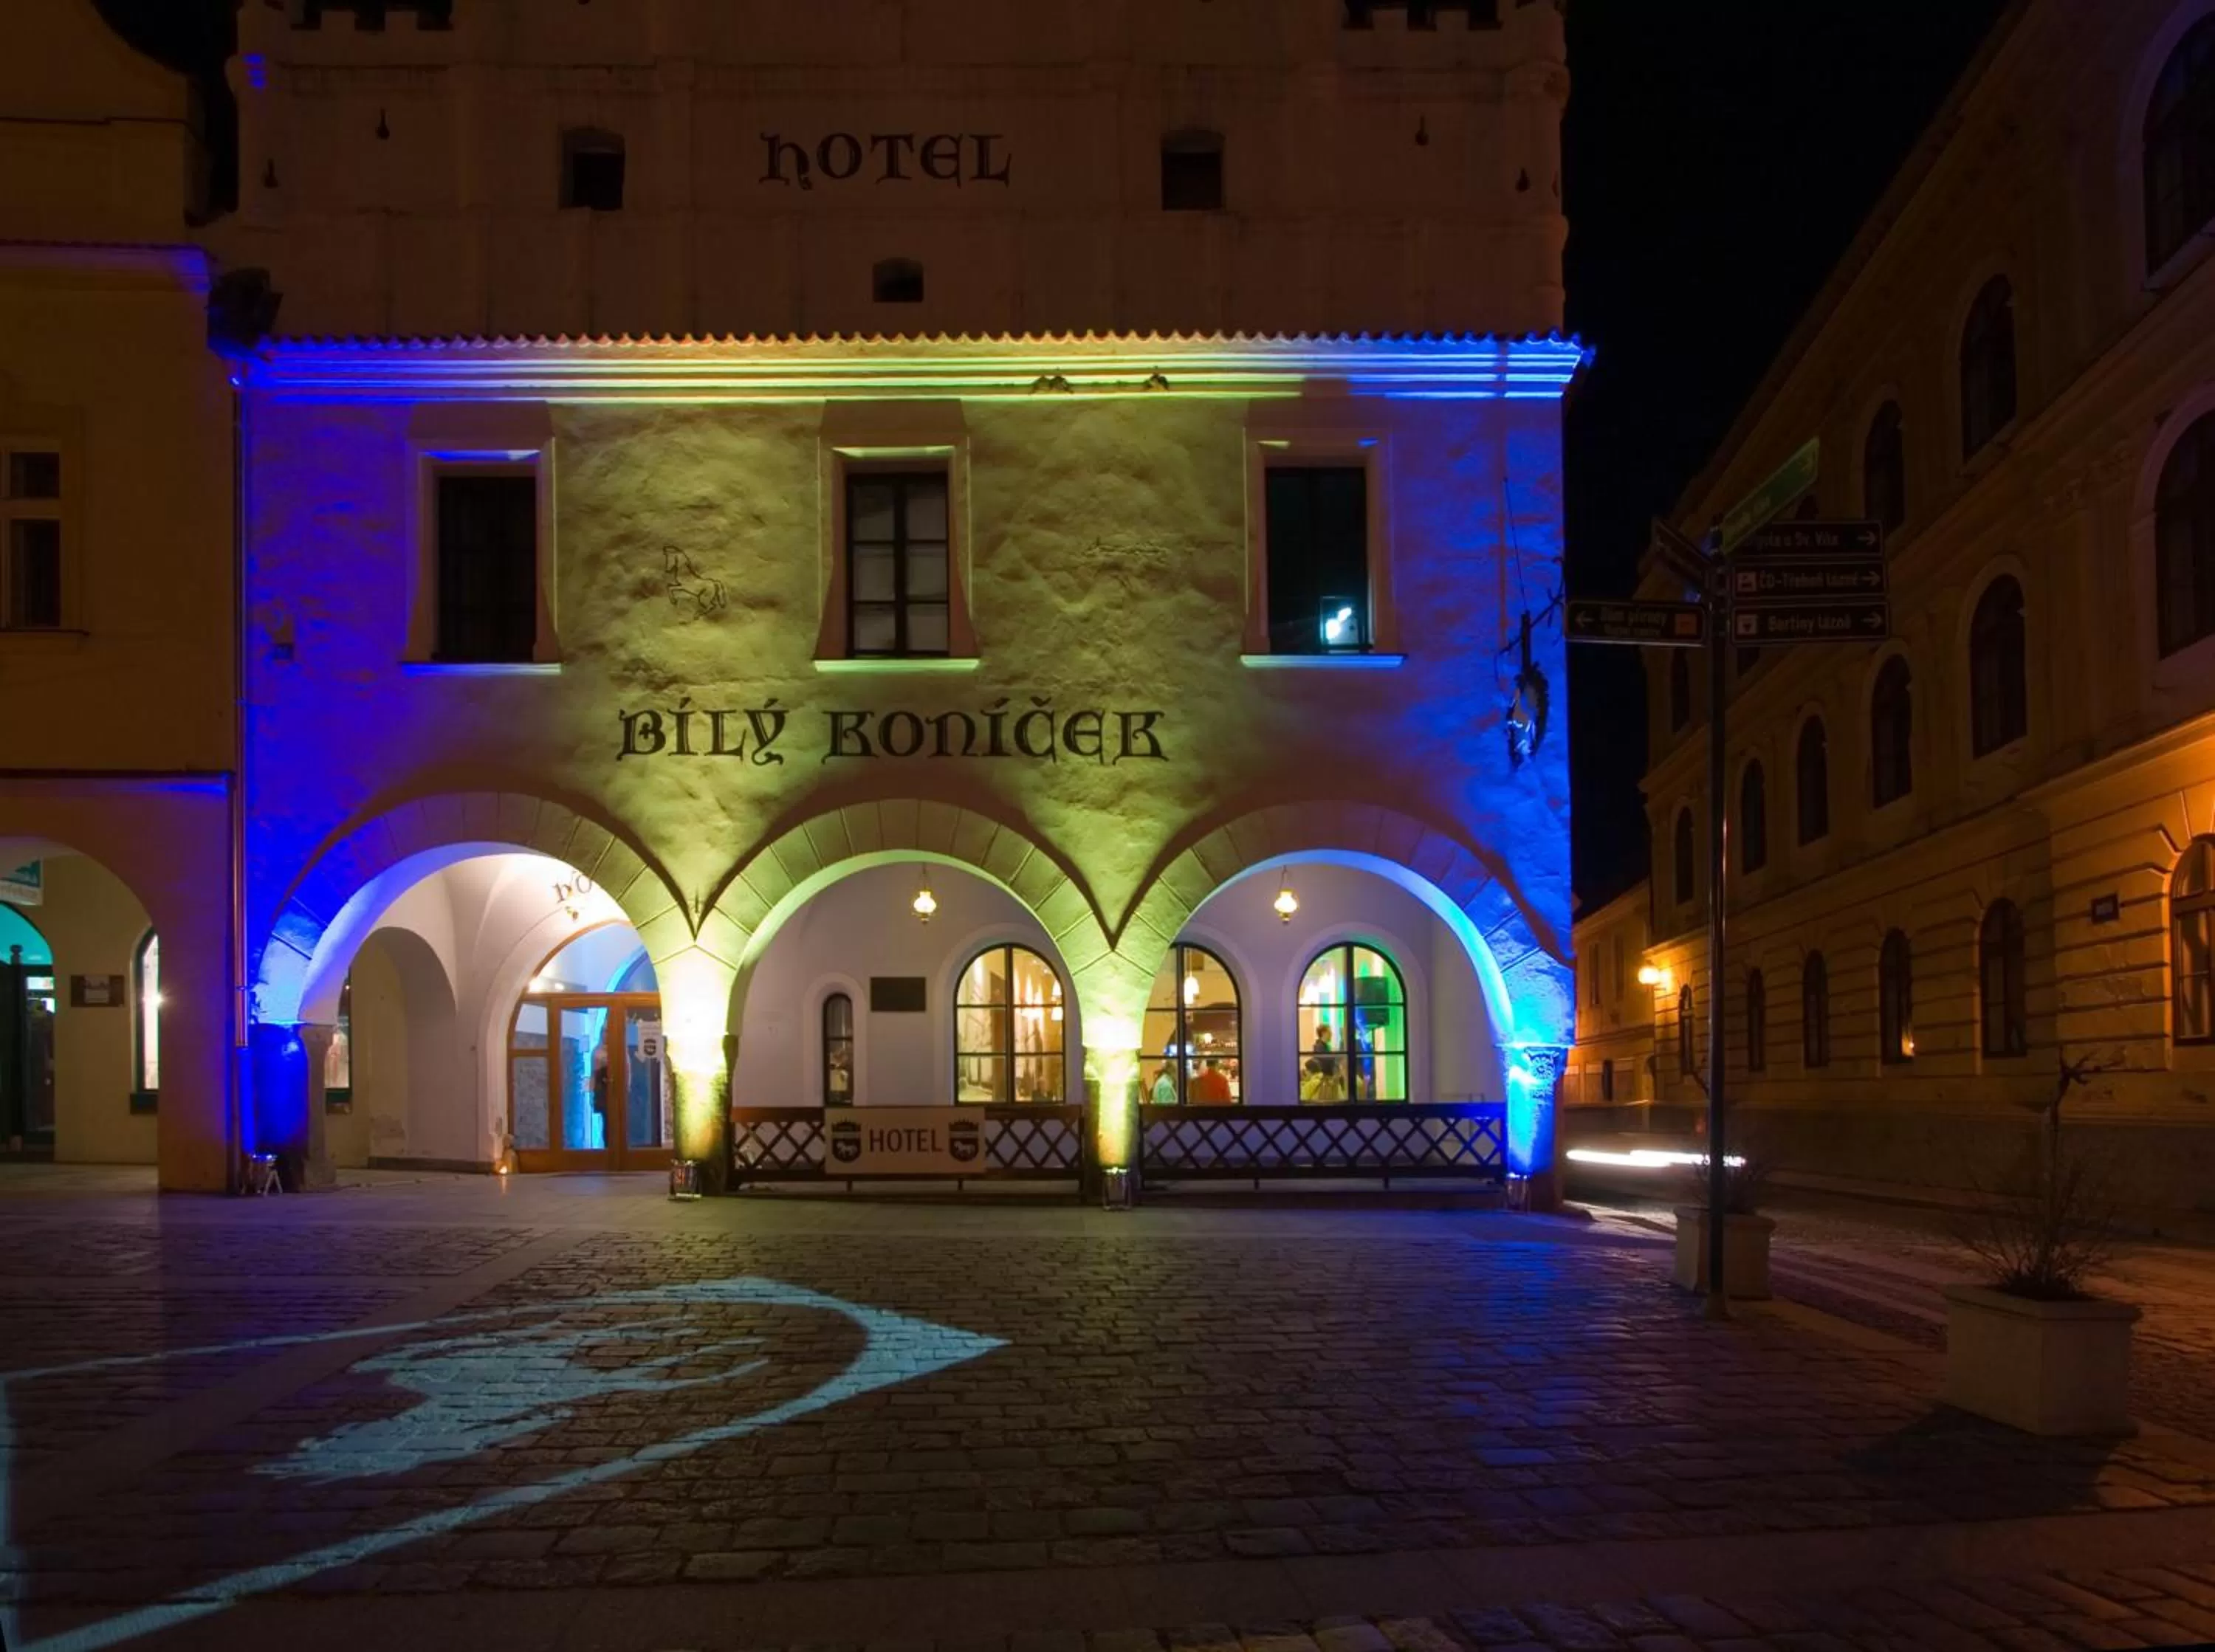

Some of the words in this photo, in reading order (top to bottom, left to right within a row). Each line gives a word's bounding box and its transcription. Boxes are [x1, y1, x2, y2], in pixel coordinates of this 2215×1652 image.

[758, 131, 1012, 190] HOTEL
[615, 696, 789, 765] BÍLÝ
[868, 1129, 944, 1153] HOTEL
